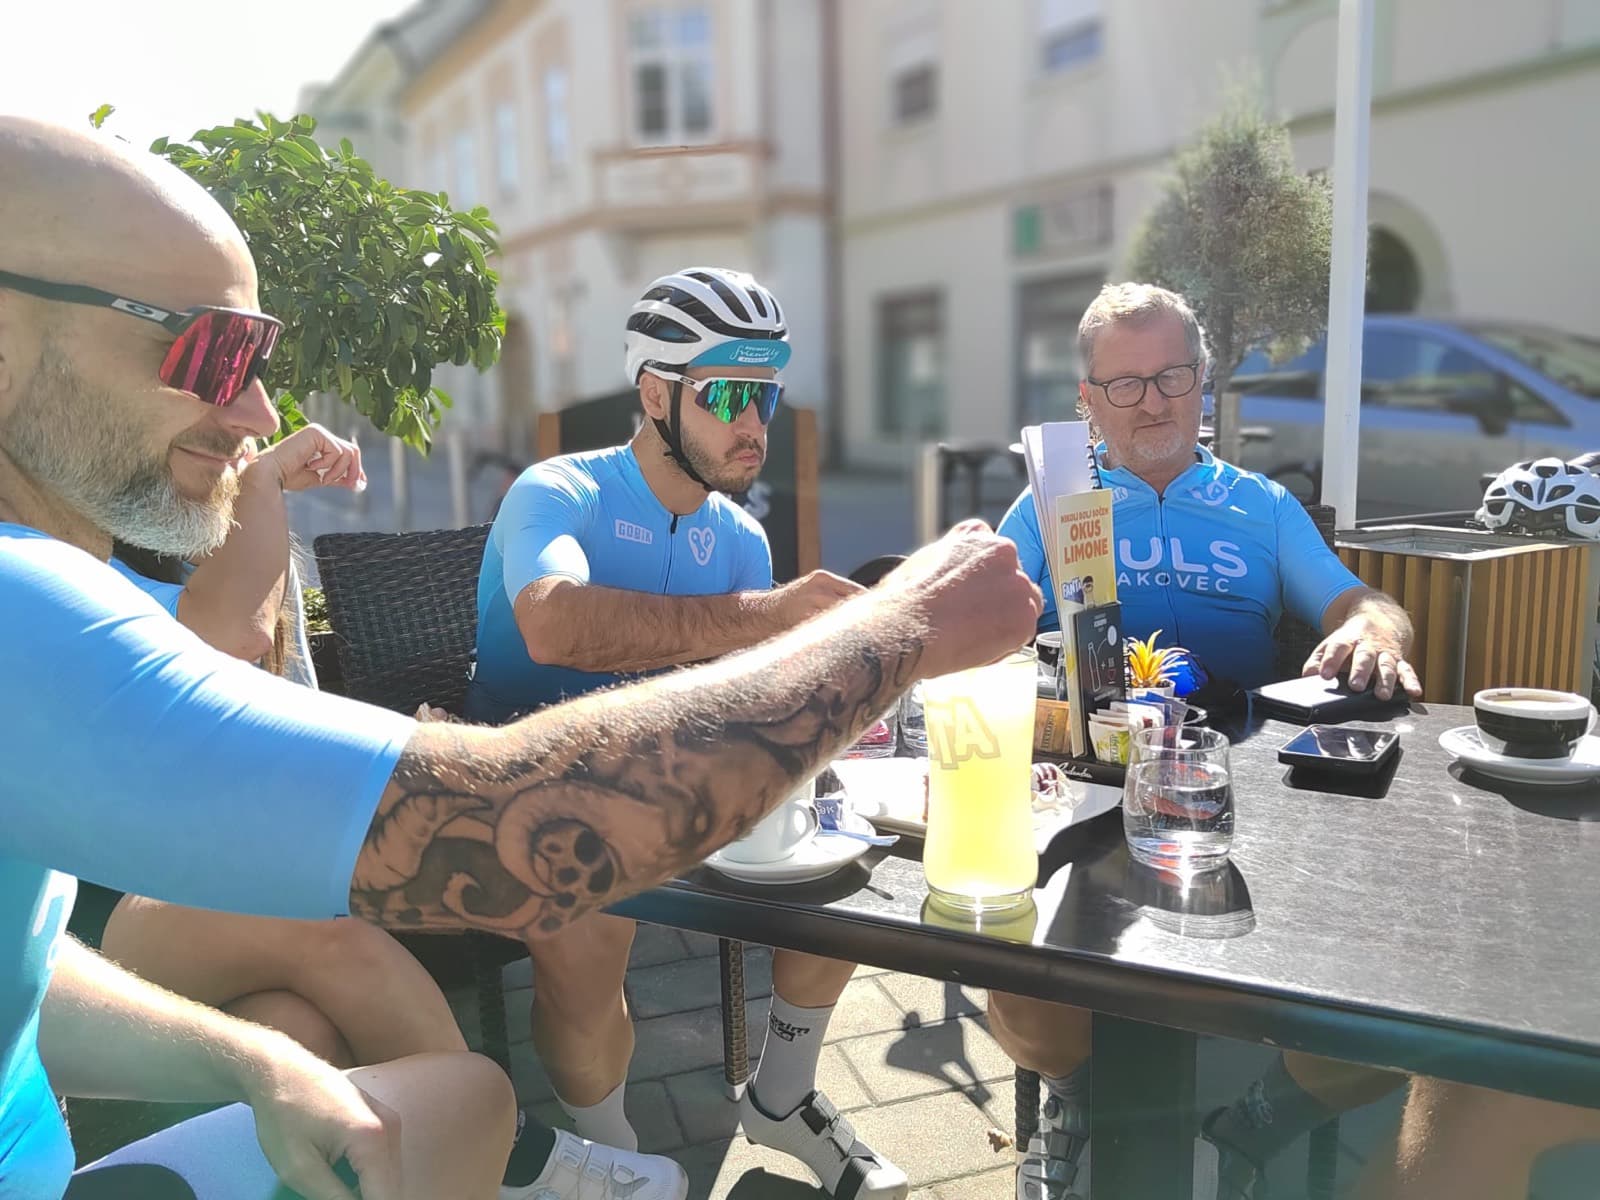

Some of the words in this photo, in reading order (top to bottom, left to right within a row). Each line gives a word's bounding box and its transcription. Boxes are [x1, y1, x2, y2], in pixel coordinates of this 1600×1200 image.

[1070, 519, 1101, 541] OKUS
[1064, 537, 1109, 565] LIMONE
[1119, 536, 1248, 578] ULS
[1117, 571, 1230, 593] AKOVEC
[926, 696, 1001, 770] TA
